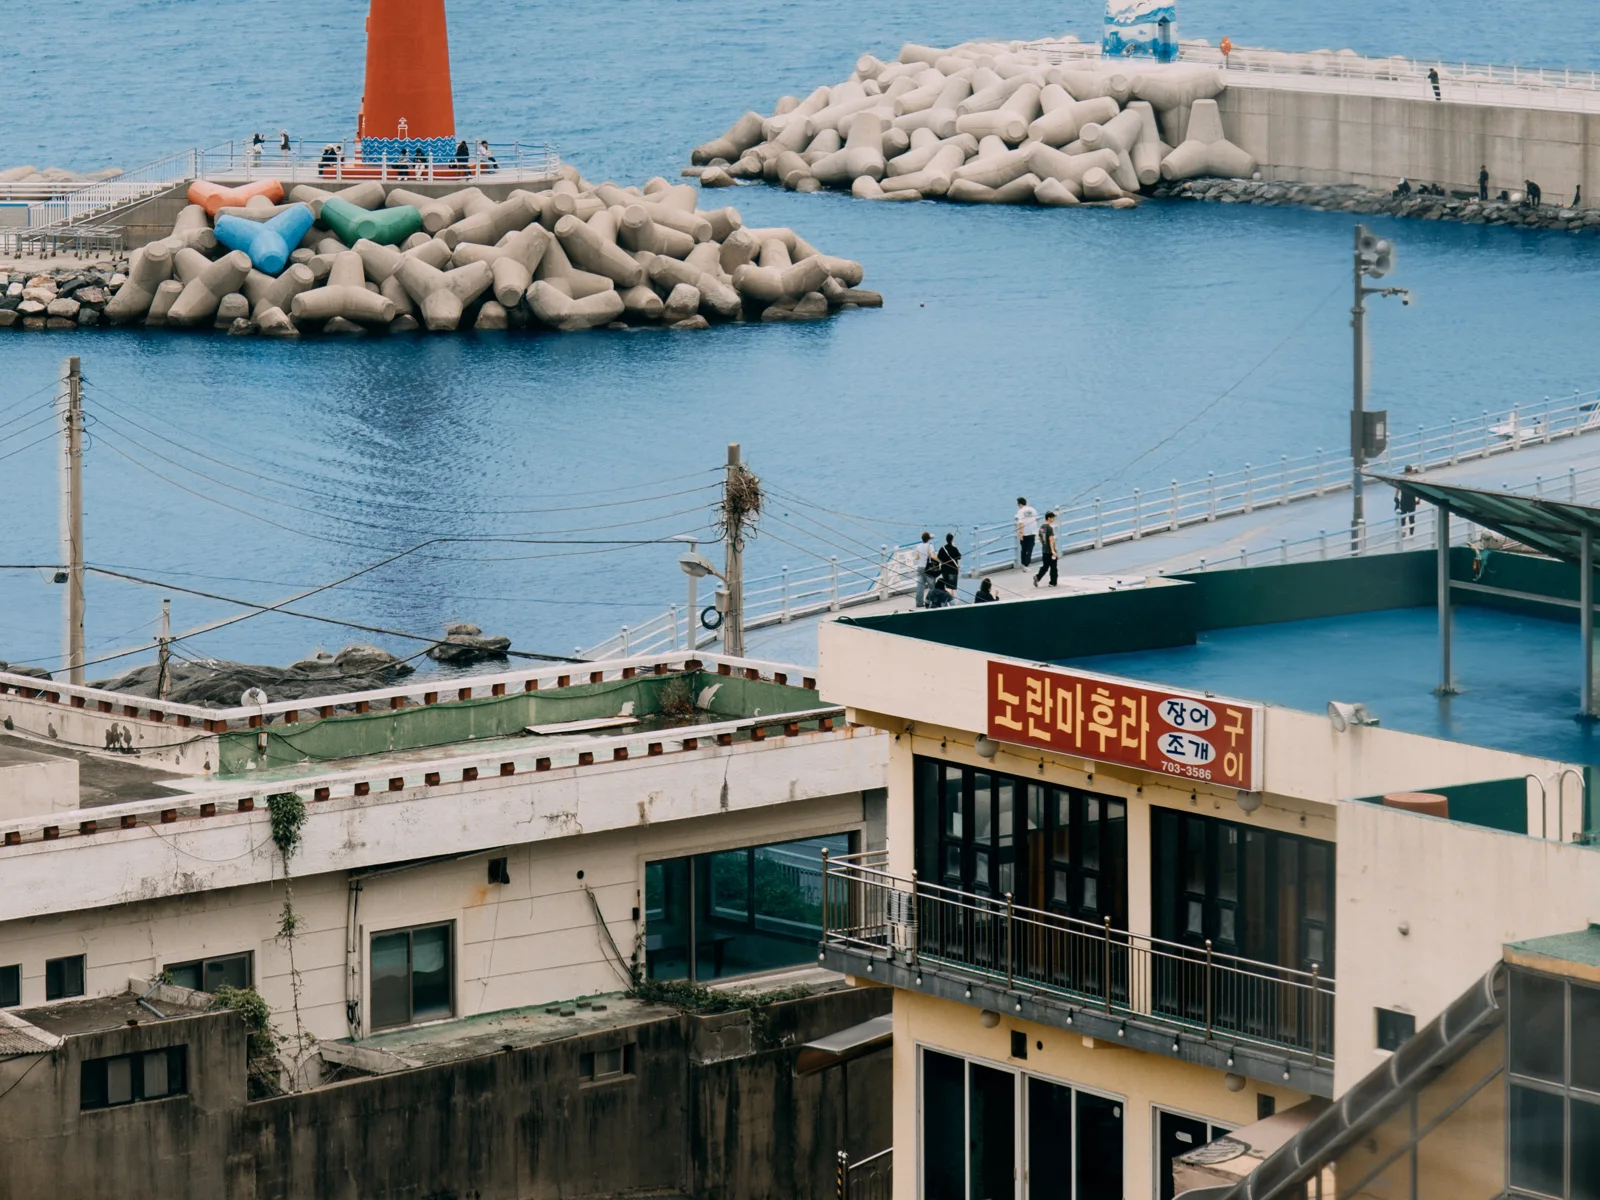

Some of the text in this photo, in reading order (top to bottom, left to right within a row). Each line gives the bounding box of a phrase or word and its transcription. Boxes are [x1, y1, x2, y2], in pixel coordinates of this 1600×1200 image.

[994, 673, 1150, 761] 노란마후라
[1166, 700, 1209, 726] 장어
[1165, 733, 1209, 761] 조개
[1223, 707, 1245, 782] 구이
[1161, 760, 1212, 780] 703-3586
